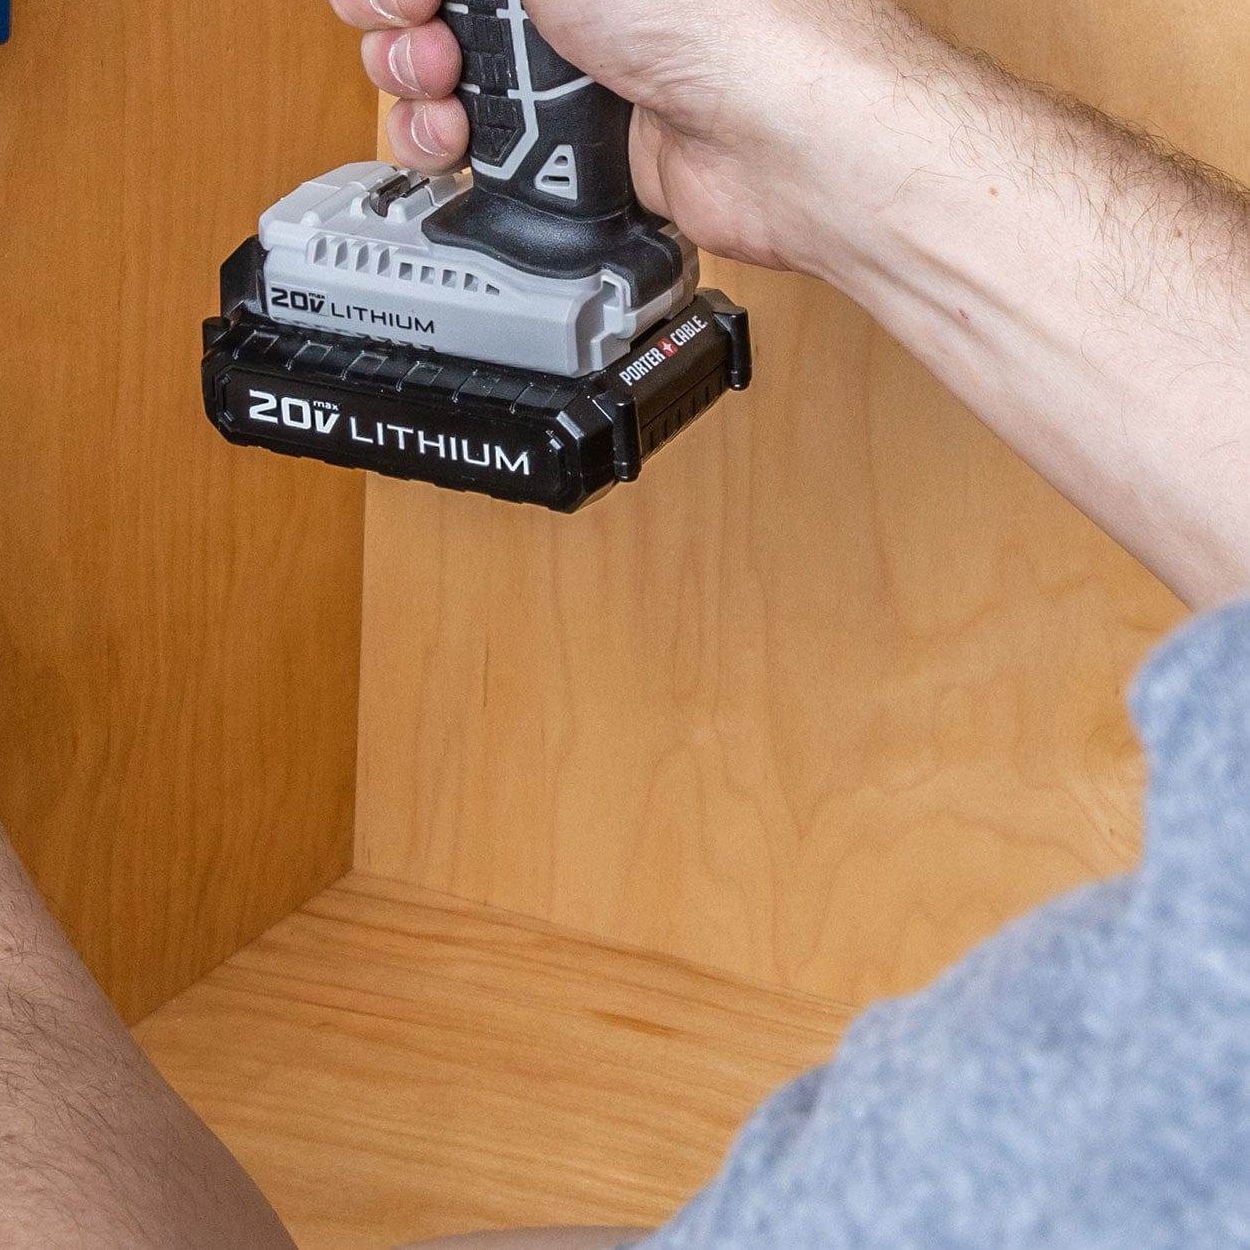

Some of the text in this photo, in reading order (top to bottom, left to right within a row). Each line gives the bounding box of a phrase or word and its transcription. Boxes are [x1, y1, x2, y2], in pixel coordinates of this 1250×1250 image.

[331, 302, 435, 334] LITHIUM
[618, 315, 707, 386] PORTER CABLE
[313, 399, 339, 412] max
[349, 416, 530, 476] LITHIUM
